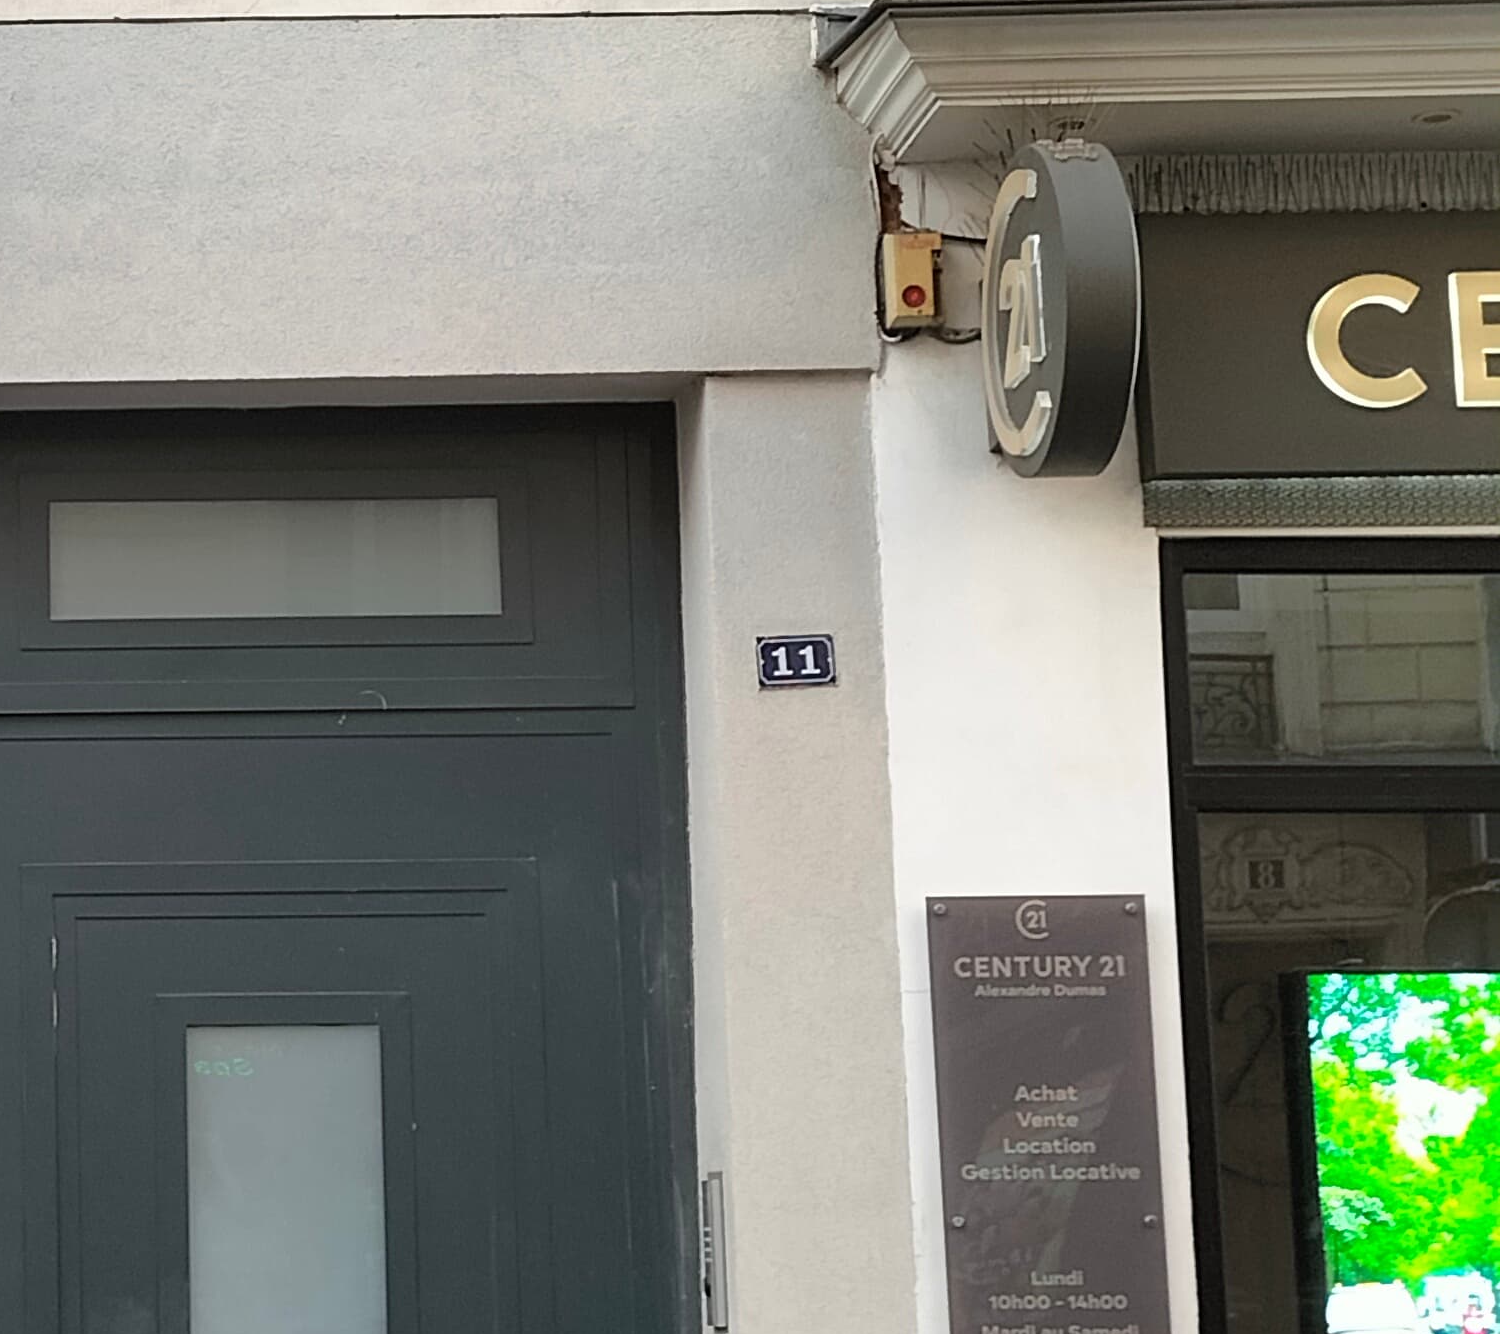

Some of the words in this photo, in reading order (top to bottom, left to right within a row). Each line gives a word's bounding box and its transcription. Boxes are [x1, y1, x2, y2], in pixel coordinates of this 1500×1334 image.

[771, 644, 821, 676] 11
[953, 955, 1092, 979] CENTURY
[1100, 955, 1125, 977] 21
[974, 984, 1050, 997] Alexandre
[1054, 984, 1106, 997] Dumas
[1014, 1085, 1078, 1102] Achat
[1016, 1112, 1079, 1128] Vente
[1003, 1137, 1096, 1154] Location
[961, 1163, 1045, 1181] Gestion
[1050, 1163, 1141, 1180] Locative
[1031, 1271, 1084, 1286] Lundi
[988, 1294, 1051, 1310] 10h00
[1067, 1294, 1128, 1310] 14h00
